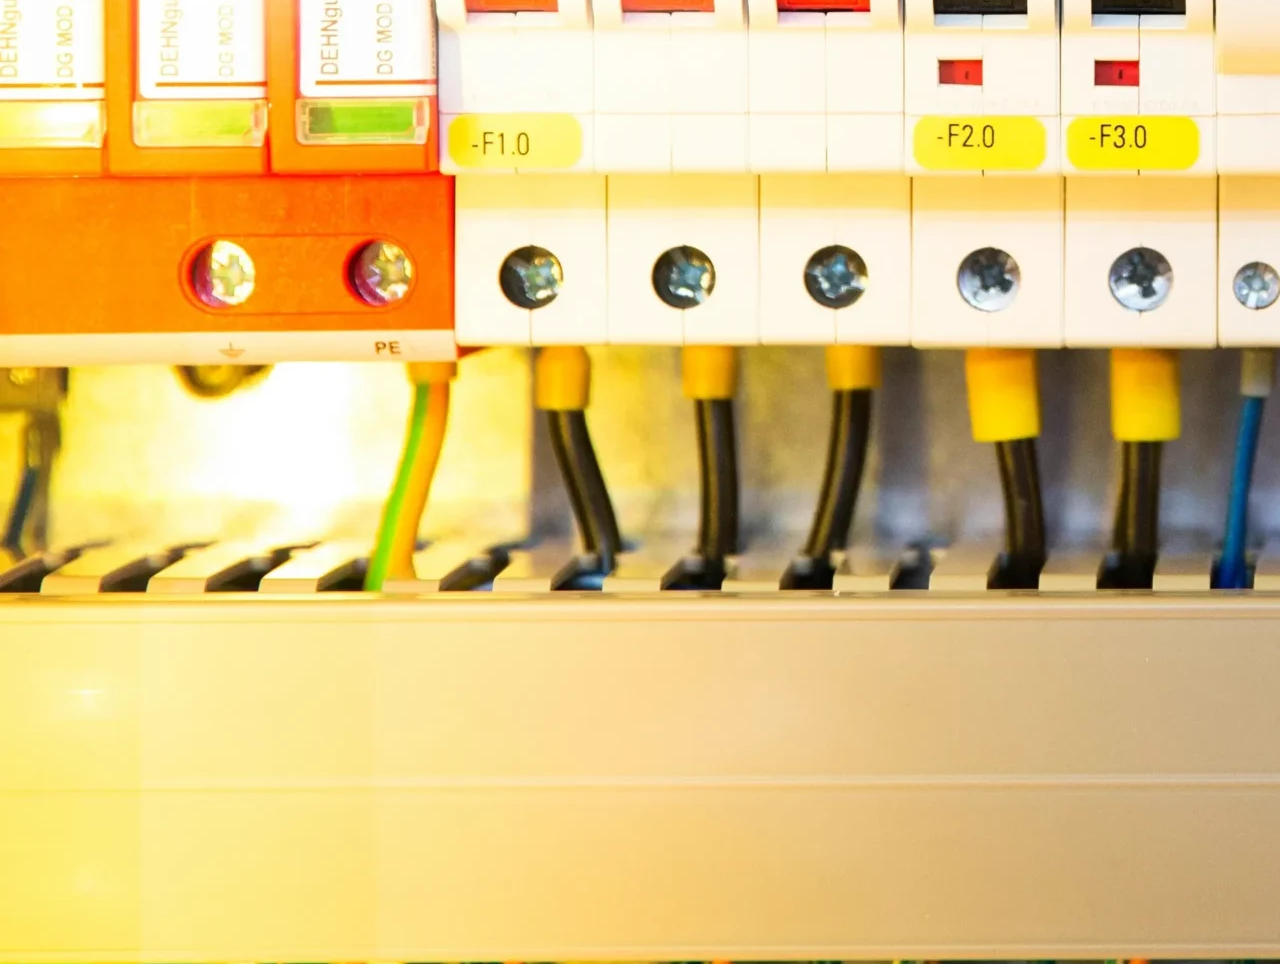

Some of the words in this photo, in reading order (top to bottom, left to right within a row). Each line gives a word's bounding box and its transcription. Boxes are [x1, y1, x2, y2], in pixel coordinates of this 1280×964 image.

[56, 6, 73, 46] MOD
[218, 5, 234, 46] MOD
[376, 3, 393, 43] MOD
[57, 52, 74, 78] DG
[218, 52, 234, 77] DG
[376, 49, 393, 75] DG
[471, 131, 531, 157] -F1.0
[937, 124, 995, 148] -F2.0
[1089, 124, 1148, 149] -F3.0
[374, 341, 401, 354] PE
